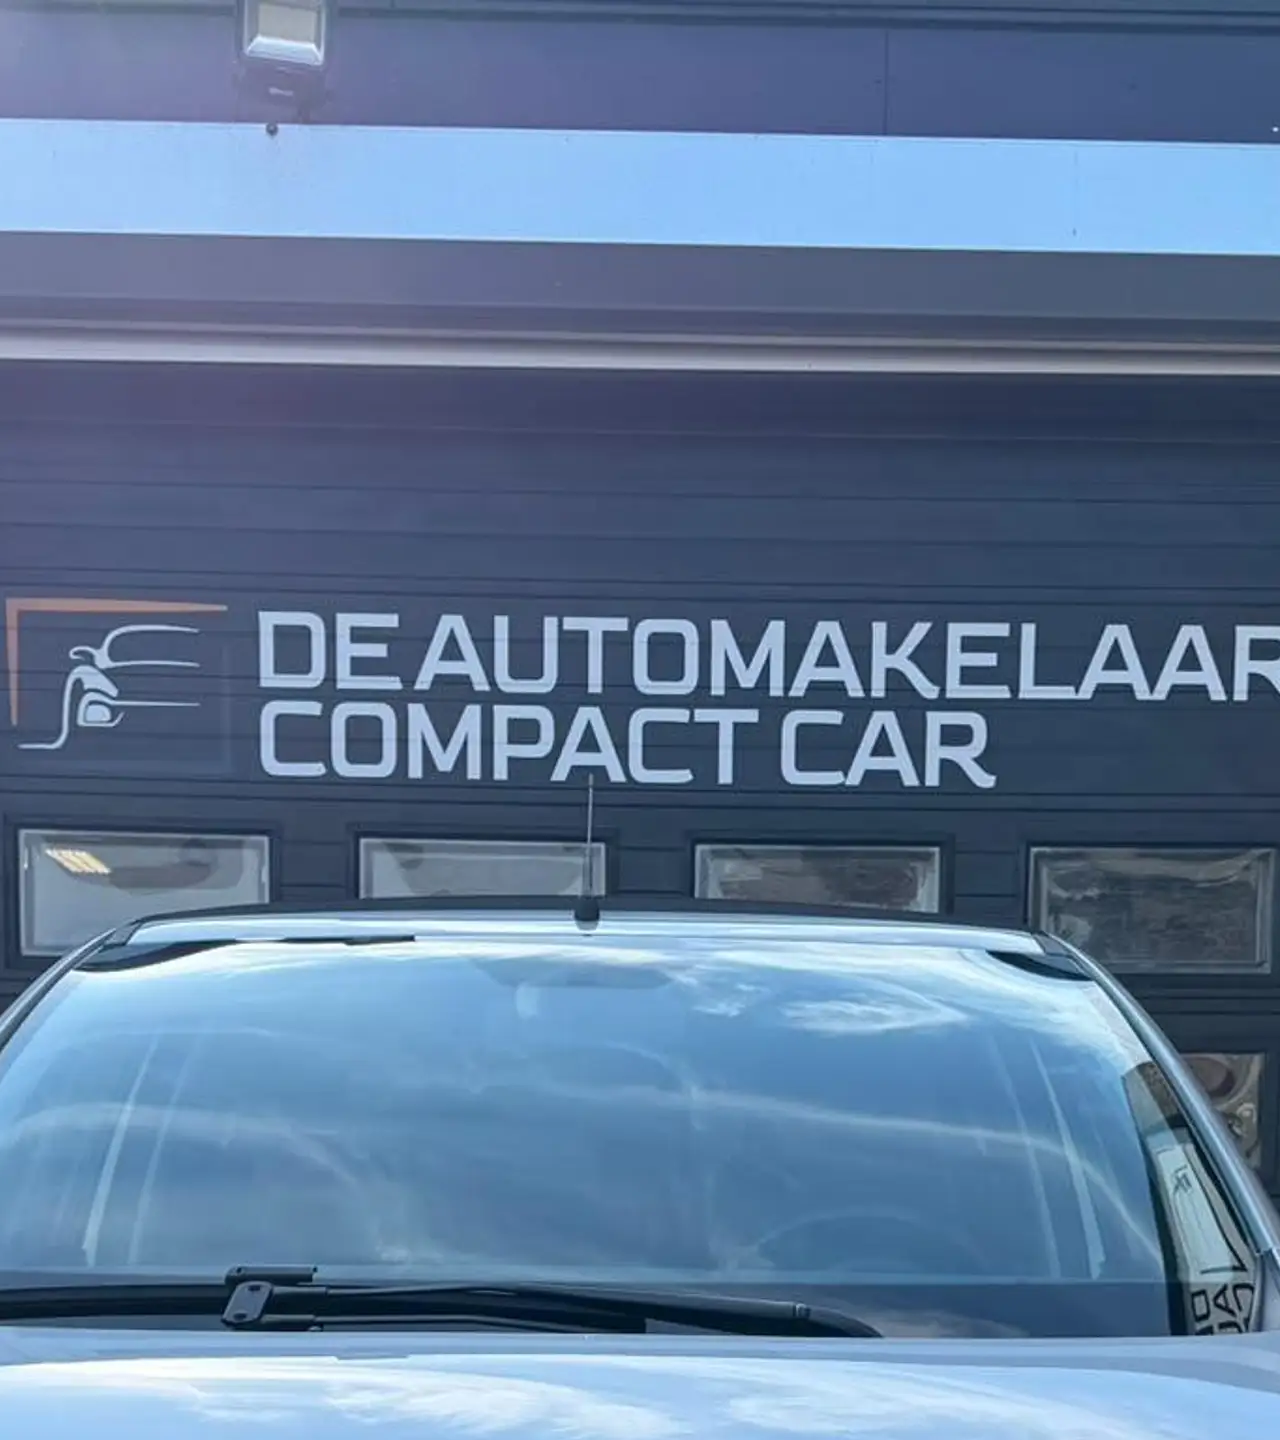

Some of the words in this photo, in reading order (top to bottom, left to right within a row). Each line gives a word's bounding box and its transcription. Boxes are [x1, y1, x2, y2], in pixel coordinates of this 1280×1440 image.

[258, 610, 402, 690] DE
[258, 700, 760, 785] COMPACT
[780, 709, 996, 788] CAR
